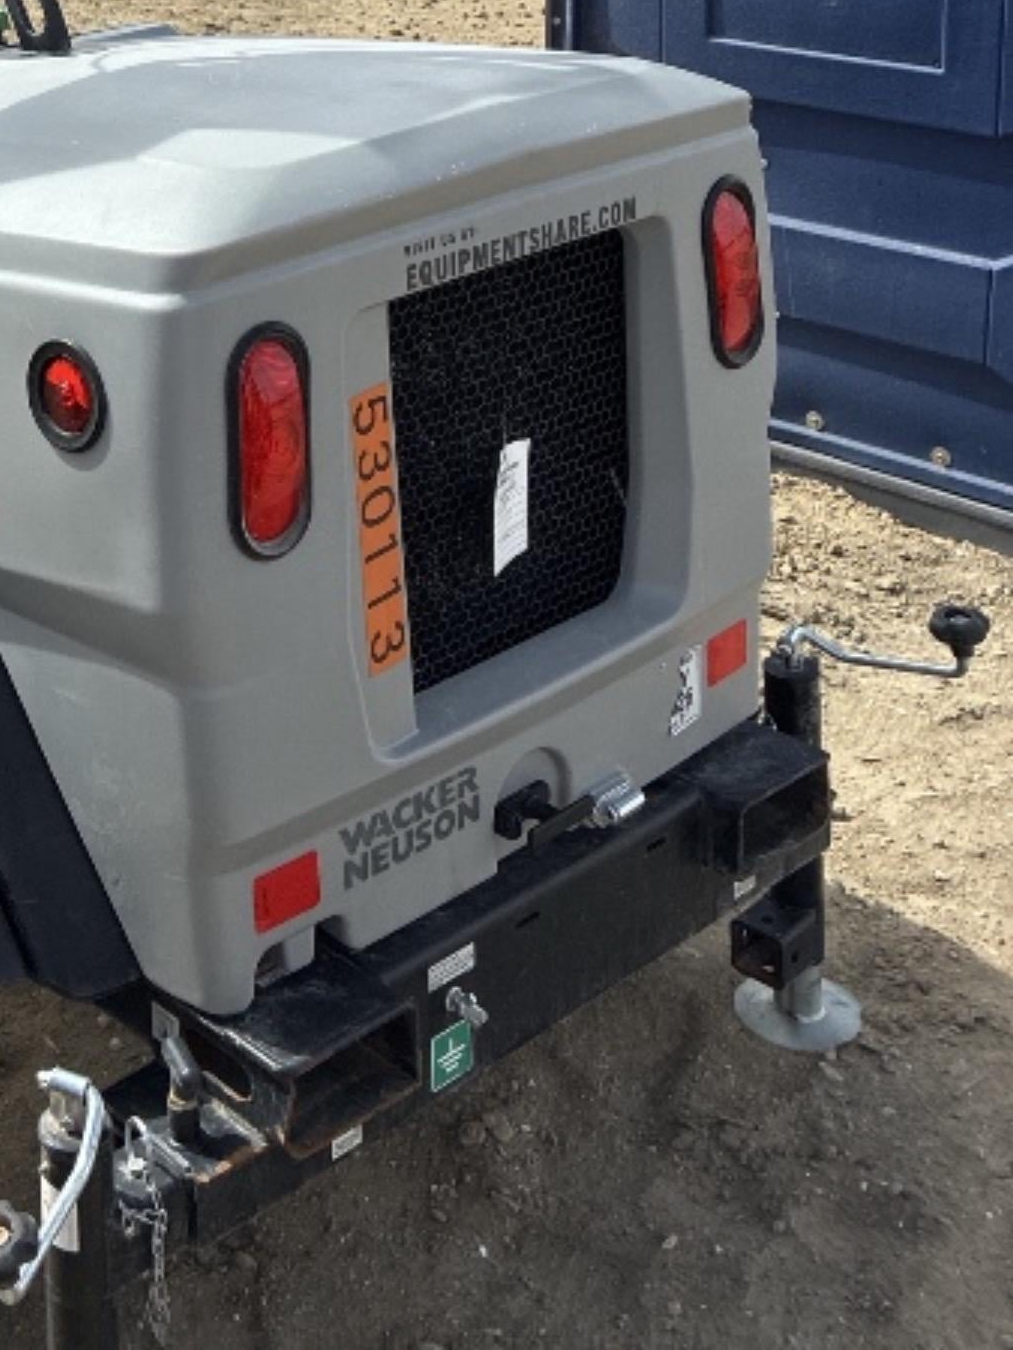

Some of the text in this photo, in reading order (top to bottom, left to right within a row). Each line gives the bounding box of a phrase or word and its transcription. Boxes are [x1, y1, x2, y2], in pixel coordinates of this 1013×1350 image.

[406, 195, 637, 291] EQUIPMENTSHARE.COM
[352, 395, 406, 663] 530113
[338, 765, 479, 856] WACKER
[343, 793, 480, 891] NEUSON
